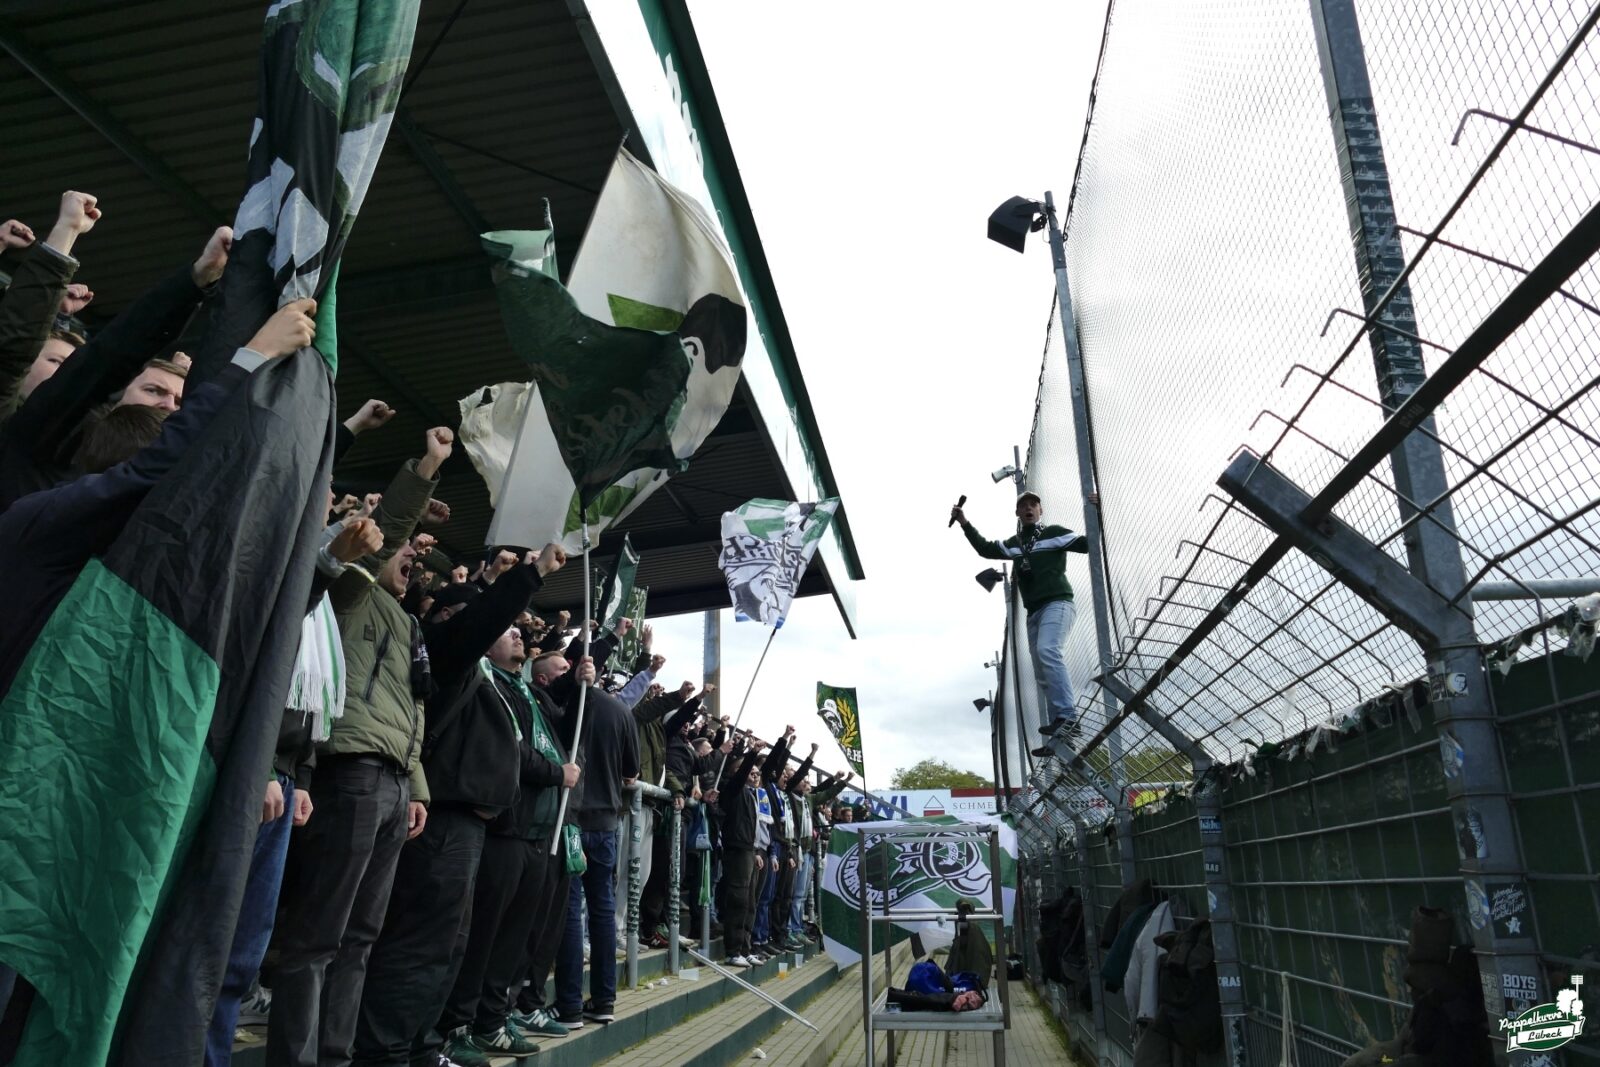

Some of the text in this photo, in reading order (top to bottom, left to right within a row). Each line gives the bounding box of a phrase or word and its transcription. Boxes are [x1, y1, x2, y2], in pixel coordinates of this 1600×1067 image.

[953, 801, 993, 810] SCHME
[1205, 863, 1219, 872] RAS
[1502, 974, 1537, 989] BOYS
[1504, 988, 1537, 1000] UNITED
